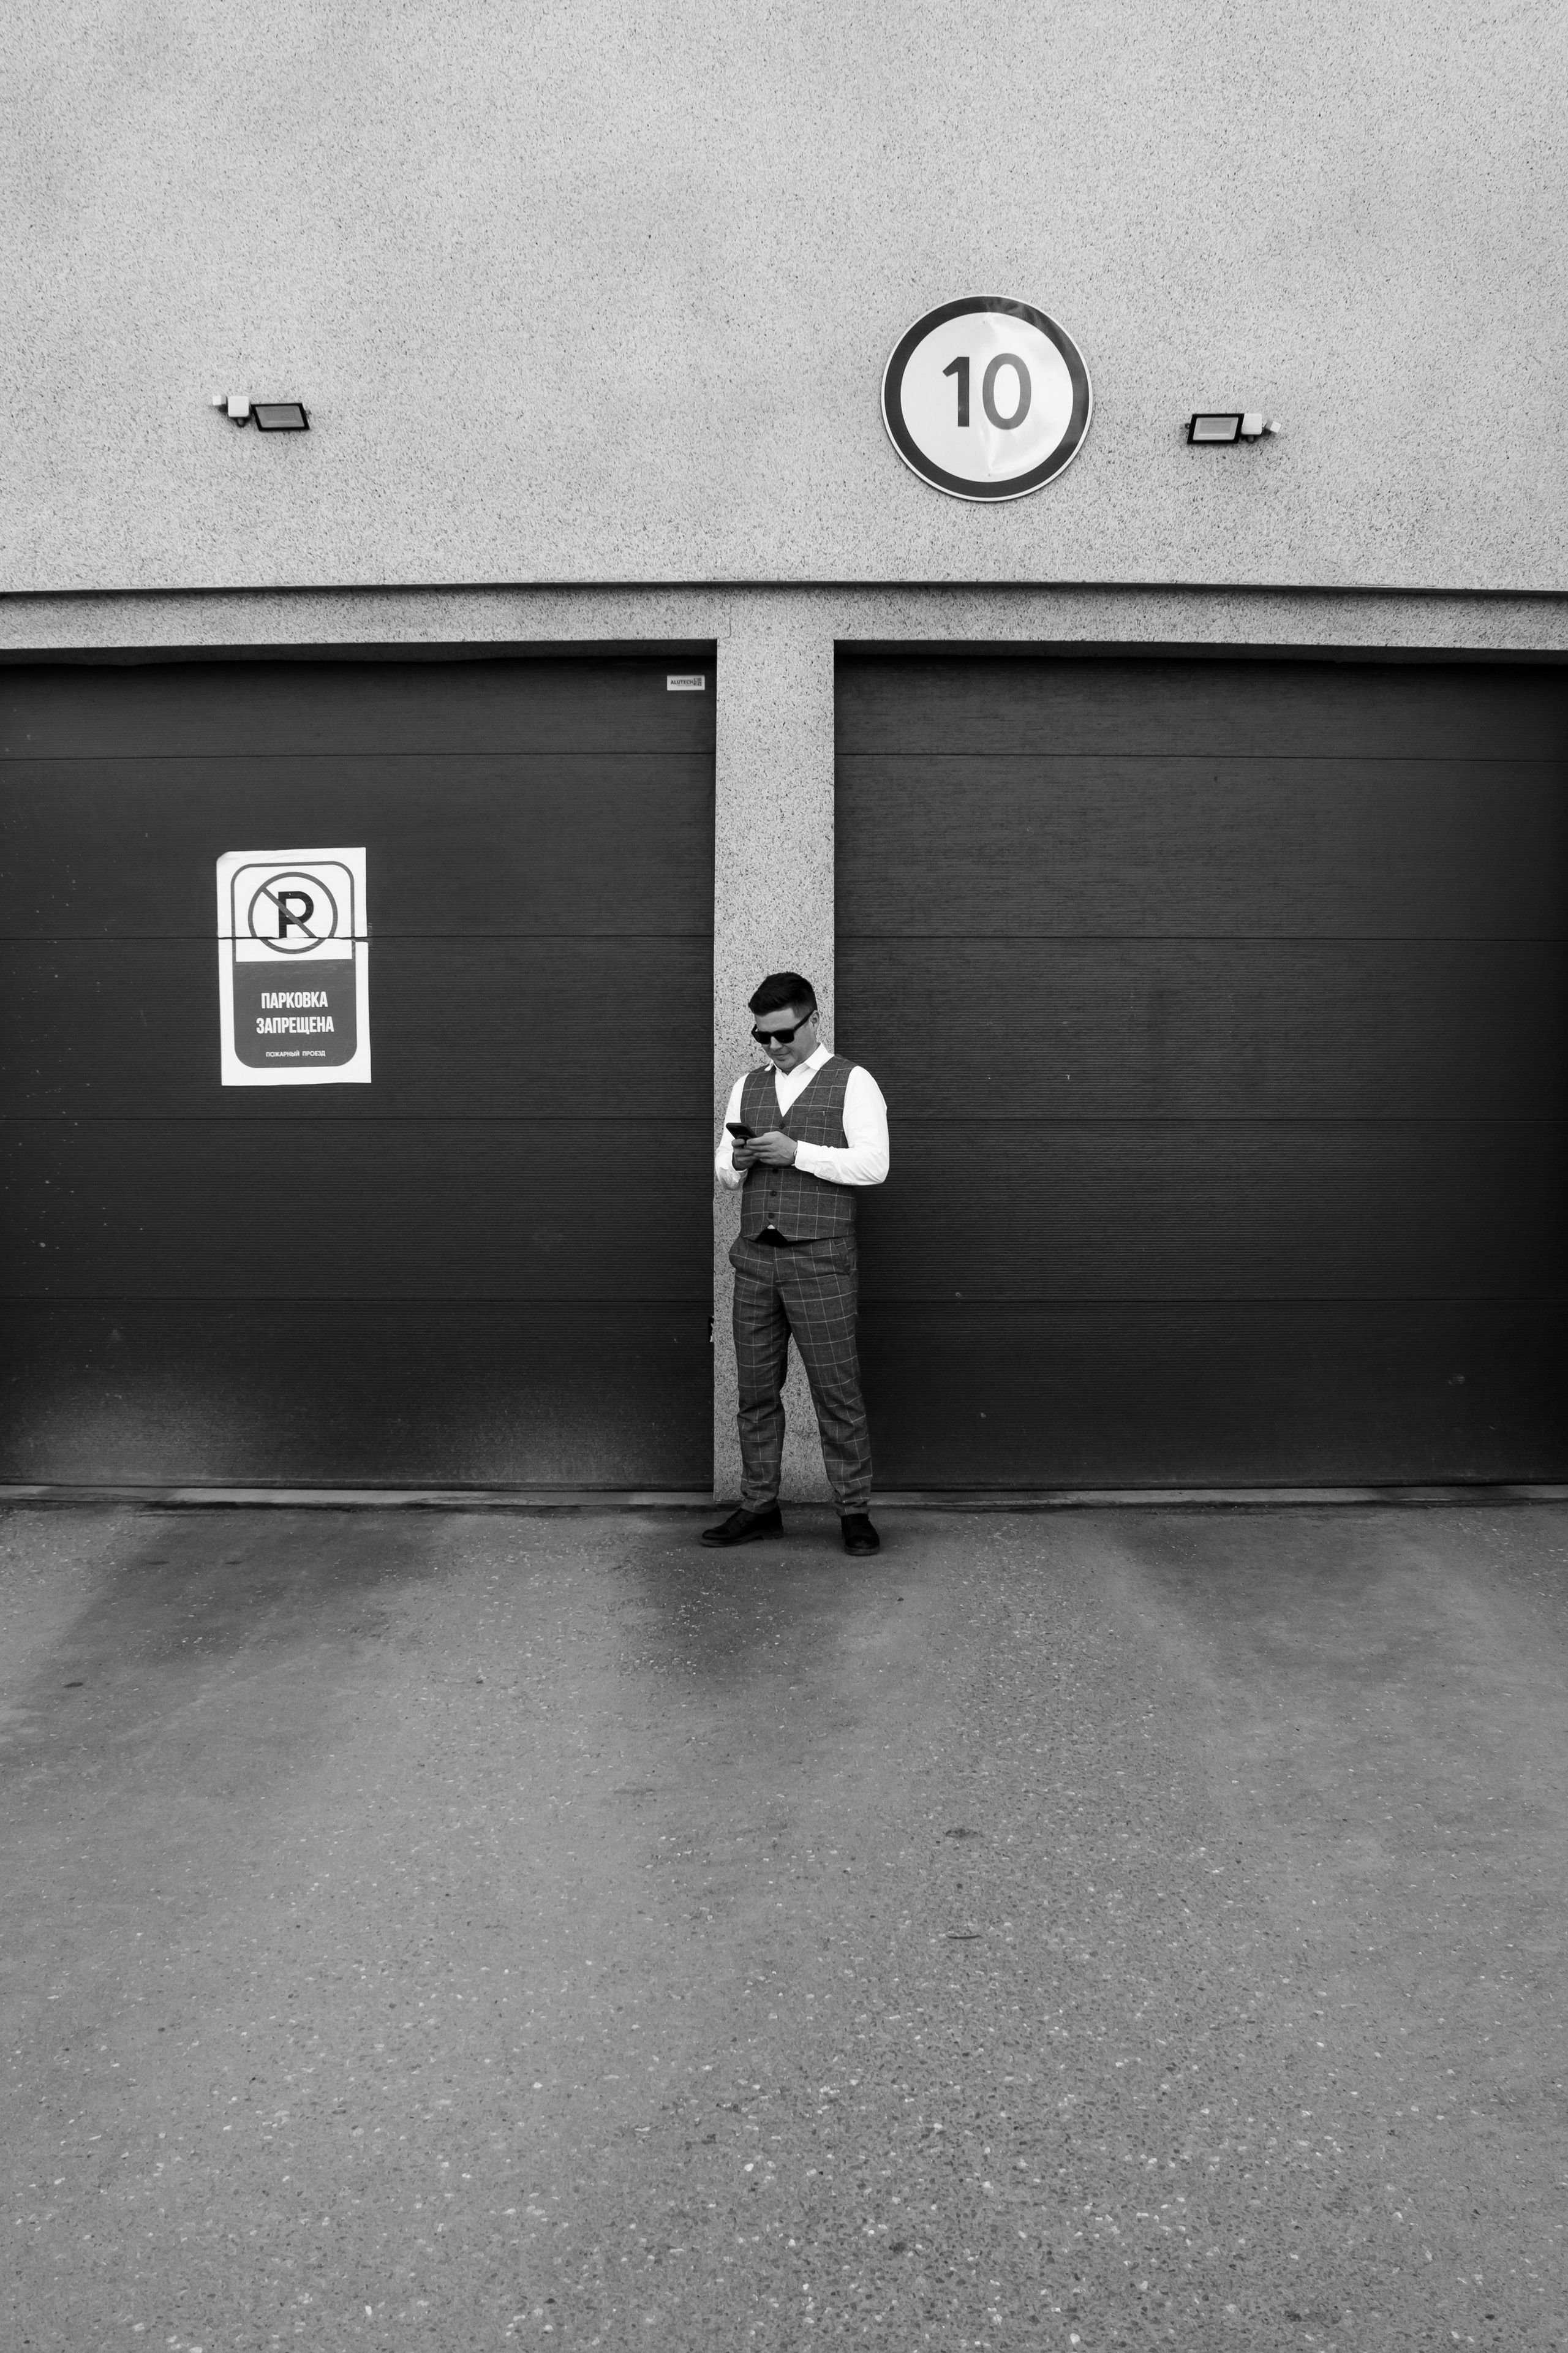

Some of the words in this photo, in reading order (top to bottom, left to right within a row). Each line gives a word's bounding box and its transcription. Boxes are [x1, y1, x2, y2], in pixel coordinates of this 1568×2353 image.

[942, 353, 1032, 430] 10
[278, 891, 314, 939] P
[261, 991, 328, 1009] ПАРКОВКА
[256, 1016, 334, 1035] ЗАПРЕЩЕНА
